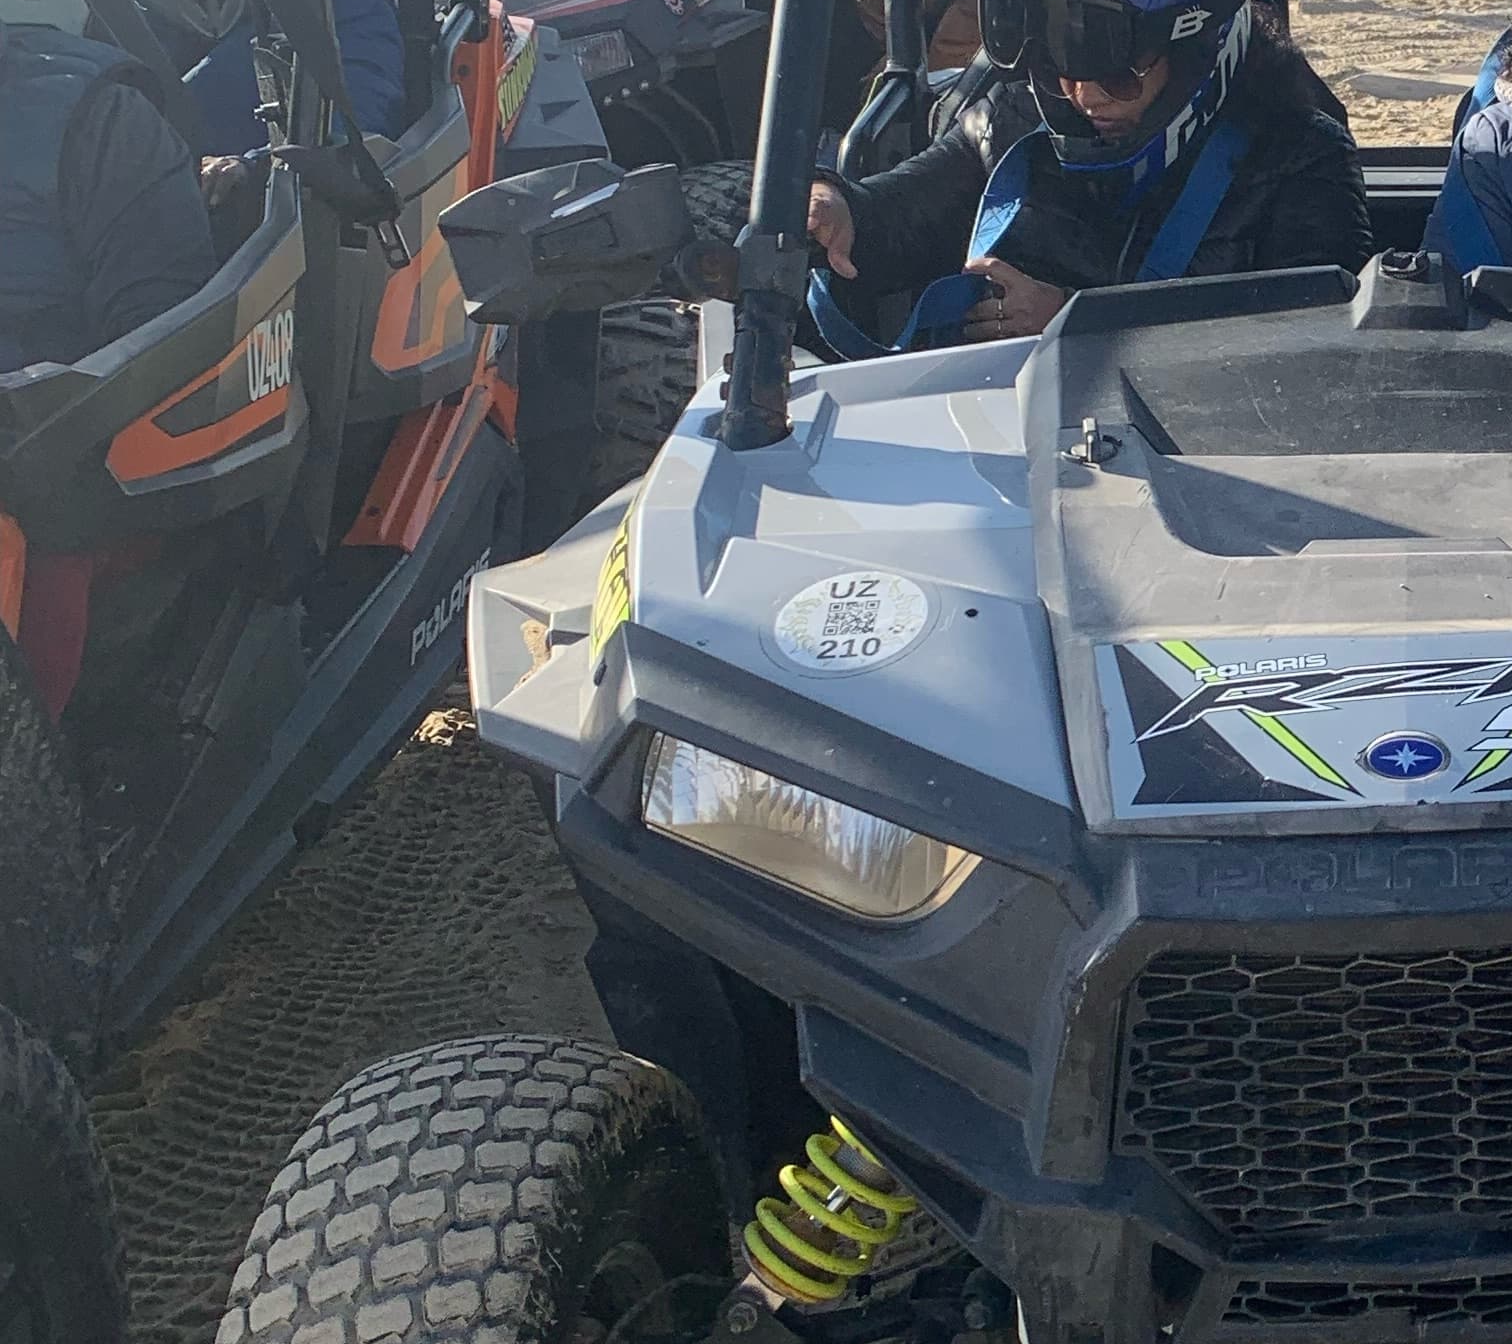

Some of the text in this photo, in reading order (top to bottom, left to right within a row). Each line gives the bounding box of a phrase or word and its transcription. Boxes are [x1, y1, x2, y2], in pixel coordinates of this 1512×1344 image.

[247, 309, 294, 402] UZ408
[830, 579, 880, 599] UZ
[816, 637, 882, 660] 210
[1195, 653, 1328, 682] POLARIS
